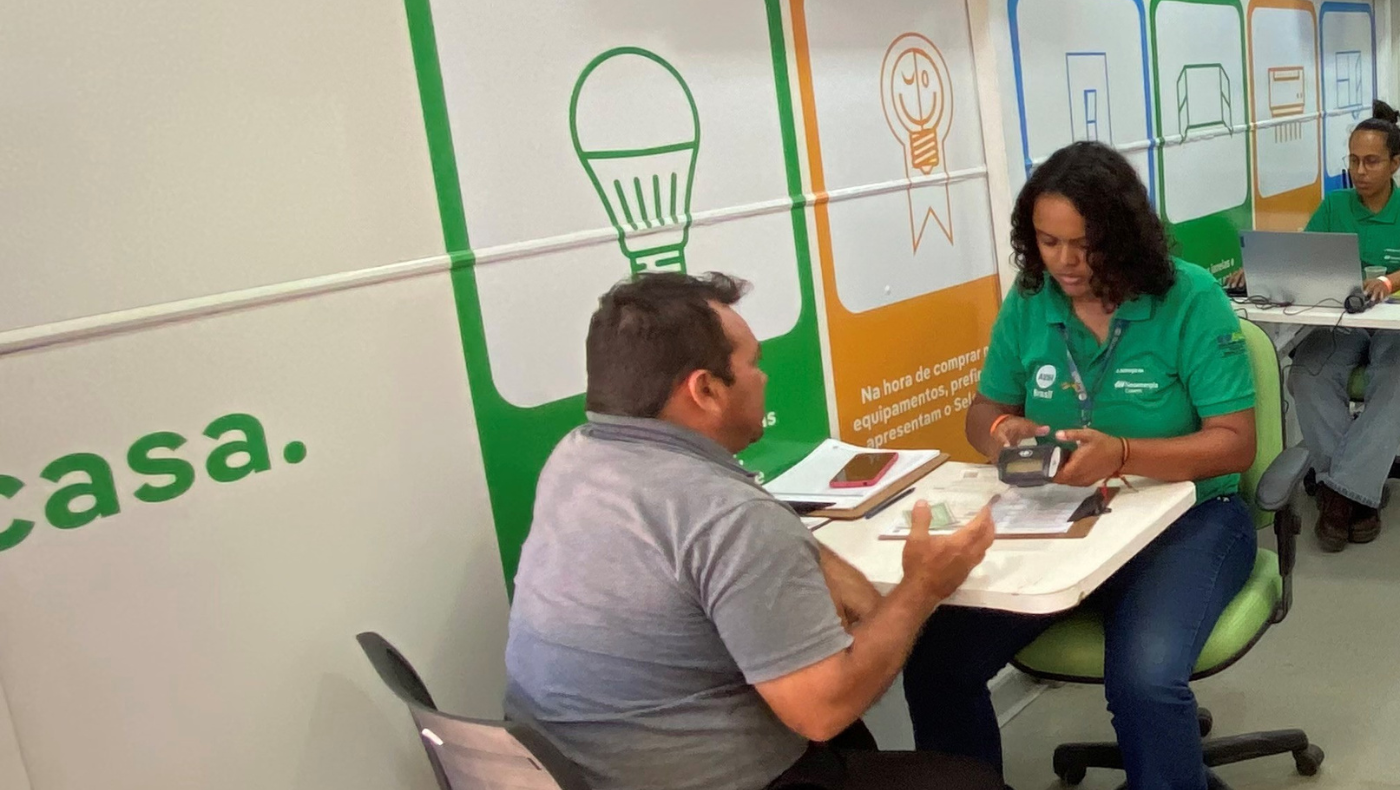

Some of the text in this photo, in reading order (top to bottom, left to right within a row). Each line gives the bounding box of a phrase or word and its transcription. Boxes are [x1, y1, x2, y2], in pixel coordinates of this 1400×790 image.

[861, 385, 881, 404] Na
[883, 374, 913, 396] hora
[915, 365, 931, 383] de
[933, 349, 981, 376] comprar
[853, 384, 949, 431] equipamentos,
[866, 391, 976, 449] apresentam o Sel
